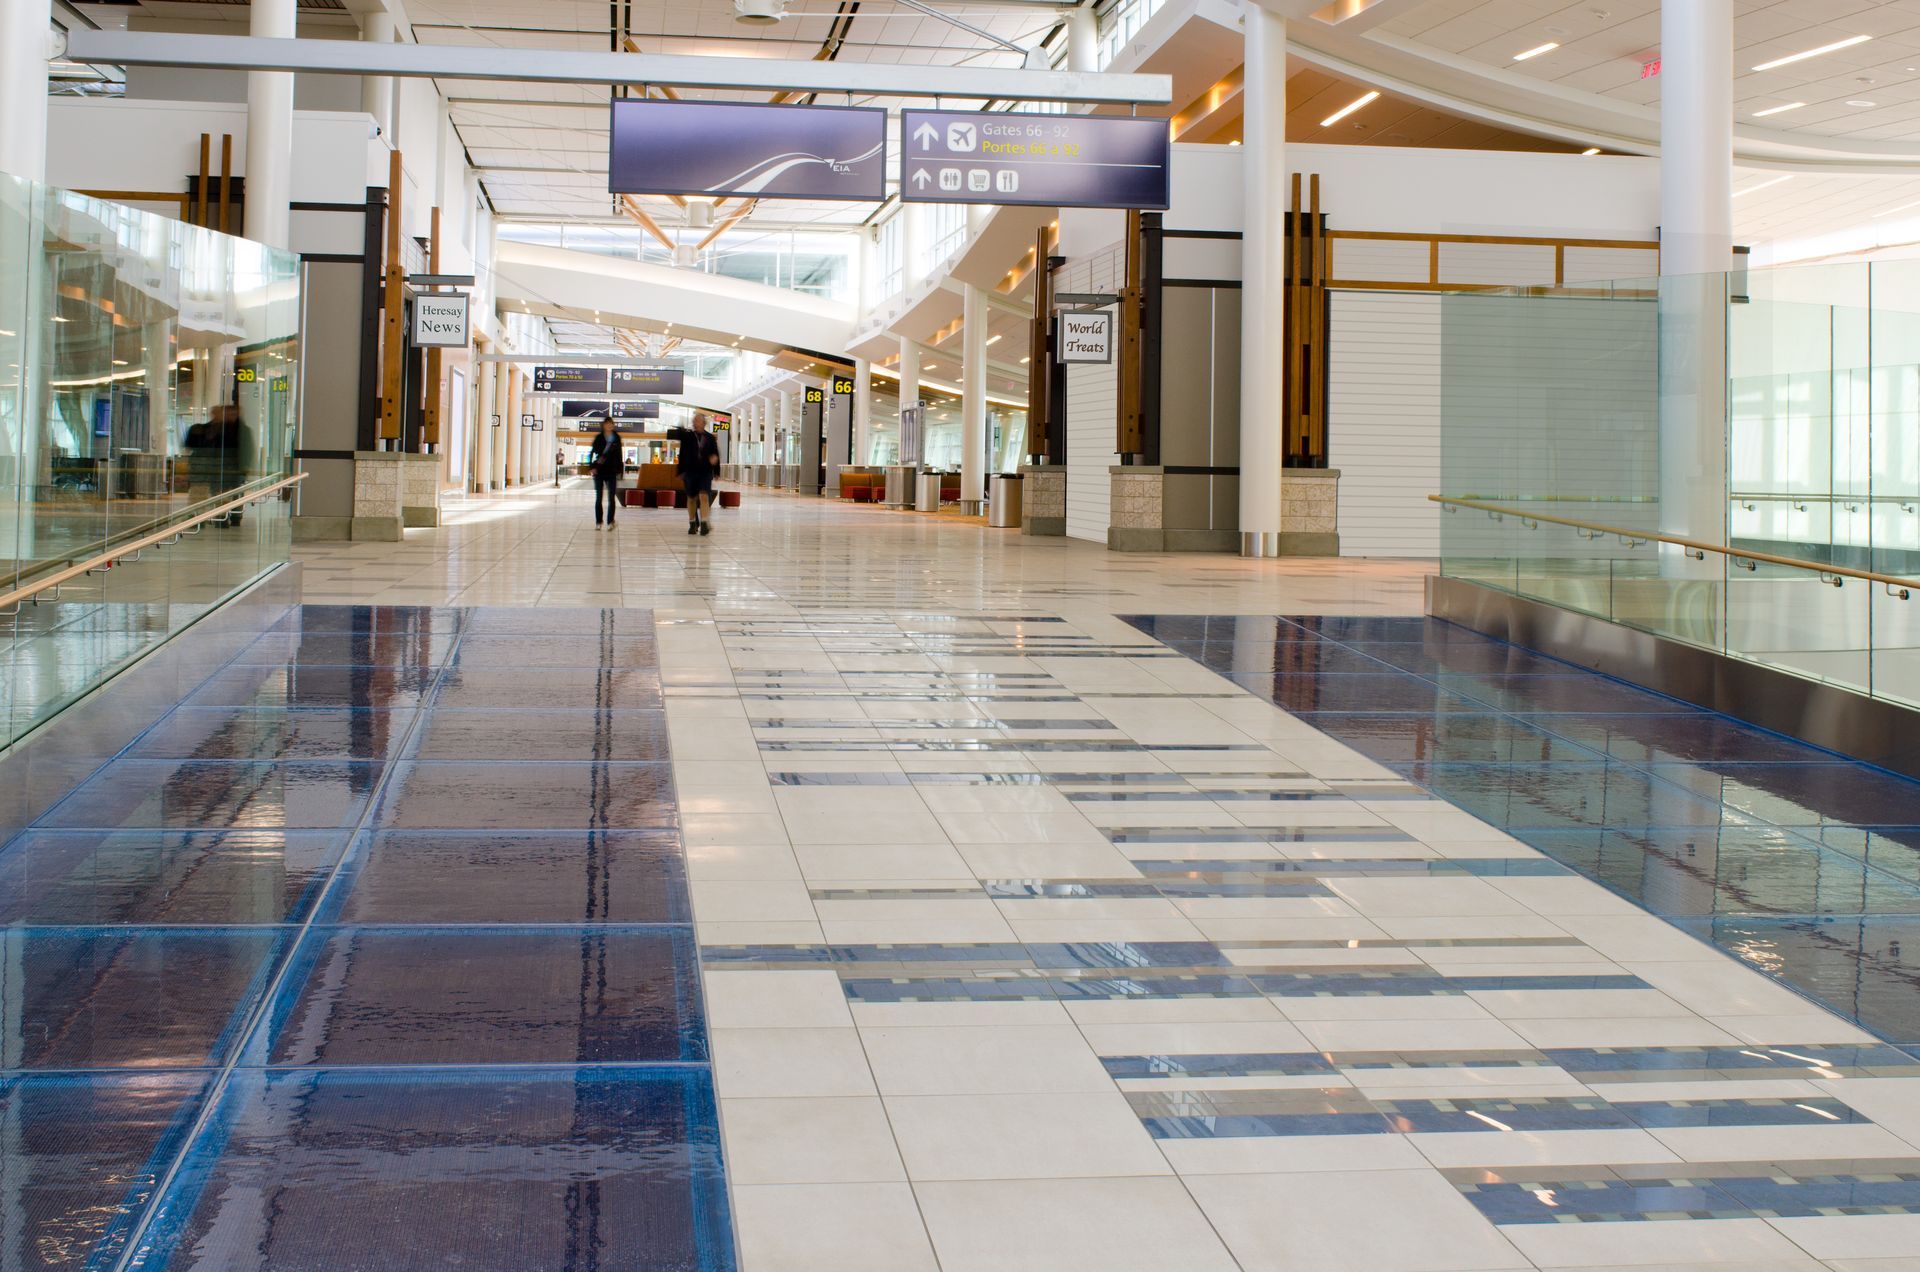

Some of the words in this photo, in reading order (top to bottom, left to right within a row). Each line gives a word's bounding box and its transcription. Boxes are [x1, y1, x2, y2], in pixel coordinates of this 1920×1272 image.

[982, 123, 1022, 136] Gates
[1026, 124, 1042, 136] 66
[1053, 125, 1070, 138] 92
[982, 141, 1026, 154] Portes
[1030, 142, 1047, 155] 66
[1063, 144, 1080, 157] 92
[422, 305, 463, 318] Heresay
[421, 320, 461, 333] News
[1067, 320, 1106, 335] World
[1066, 338, 1104, 353] Treats
[835, 381, 852, 393] 66
[807, 391, 822, 402] 68
